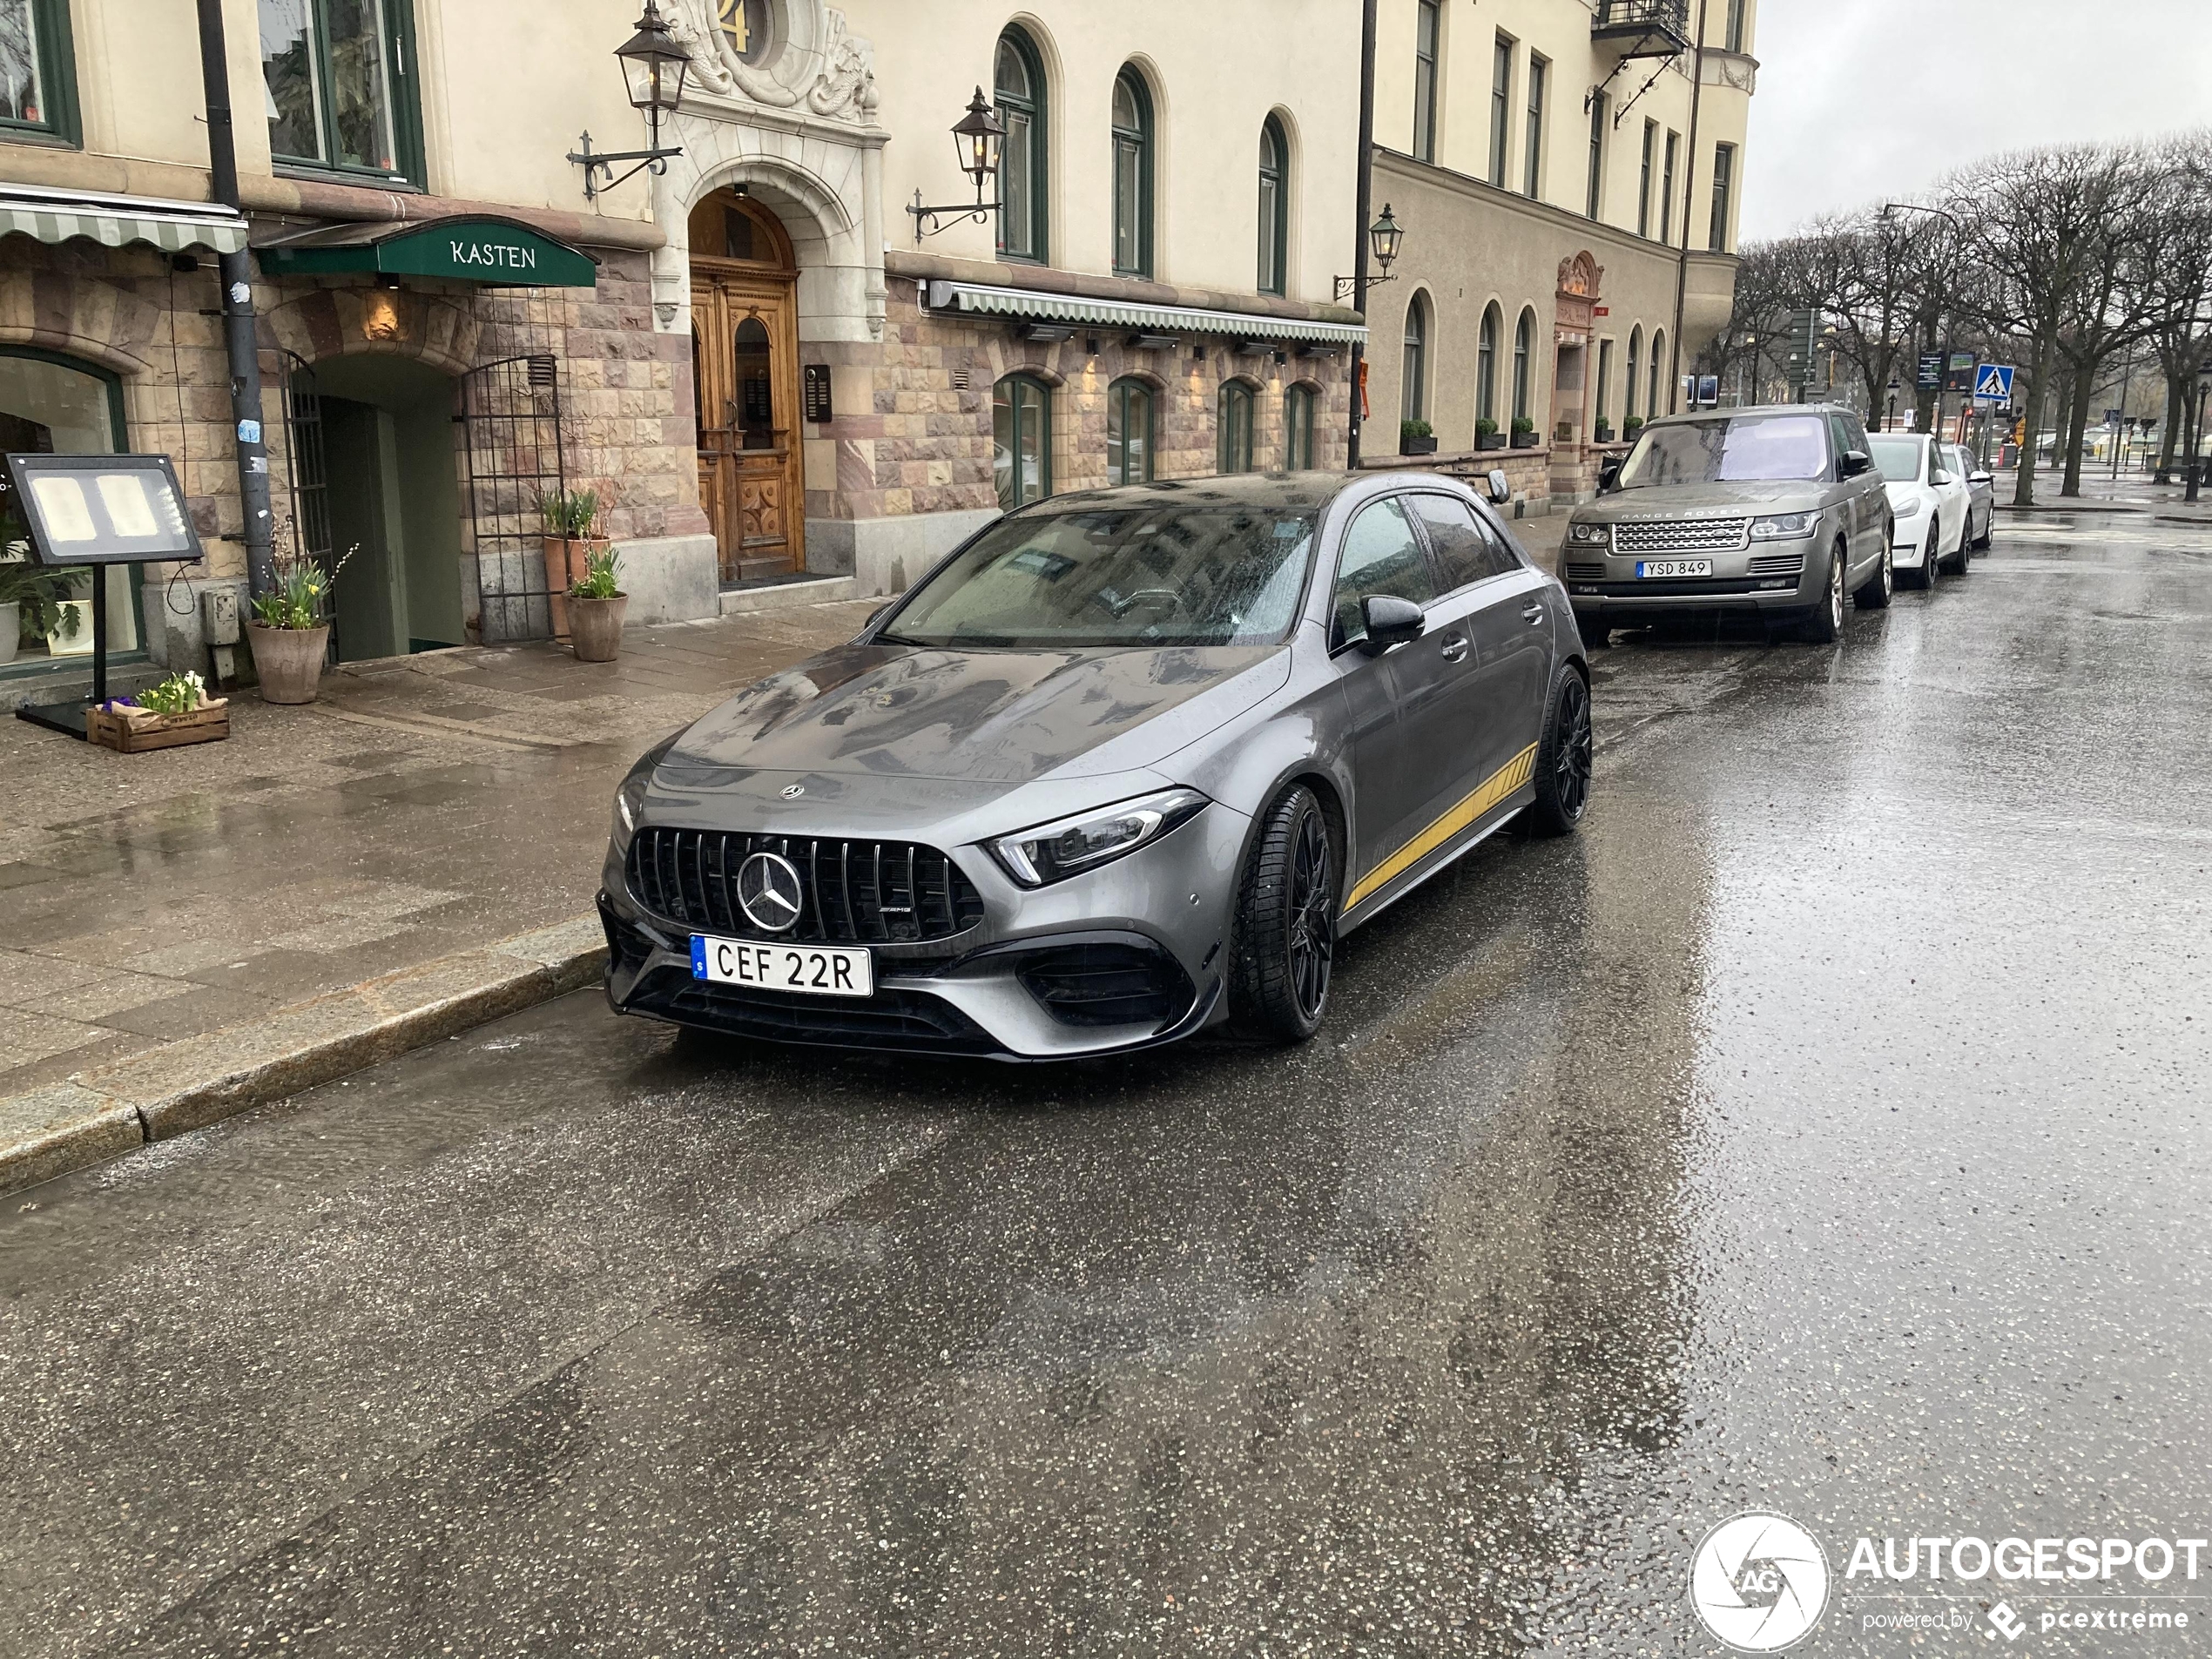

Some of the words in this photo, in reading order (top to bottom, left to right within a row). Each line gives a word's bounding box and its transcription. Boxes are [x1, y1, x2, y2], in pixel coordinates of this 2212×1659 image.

[449, 240, 536, 269] KASTEN
[1684, 509, 1741, 517] ROVER
[1649, 563, 1674, 575] YSD
[1679, 562, 1705, 575] 849
[697, 961, 704, 971] S
[718, 944, 771, 981] CEF
[786, 952, 853, 989] 22R
